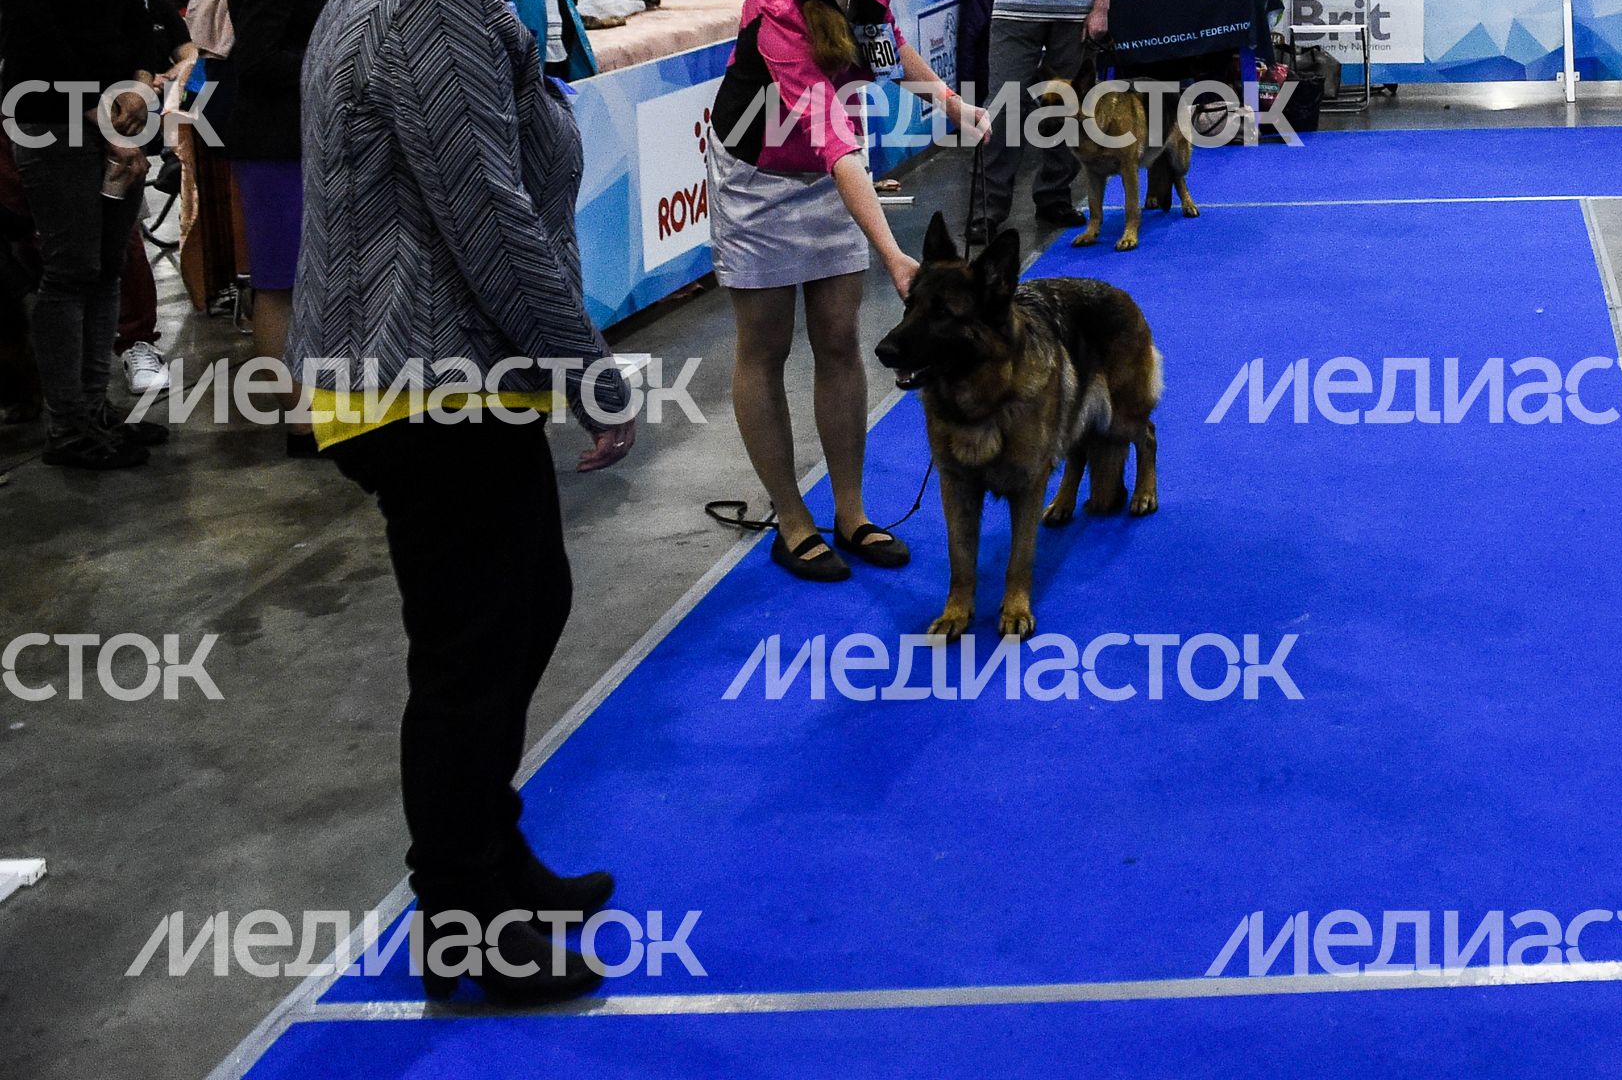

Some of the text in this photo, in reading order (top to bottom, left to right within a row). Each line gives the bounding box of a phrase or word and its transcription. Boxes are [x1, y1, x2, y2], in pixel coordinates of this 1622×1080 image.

[1132, 31, 1198, 48] KYNOLOGICAL
[1200, 22, 1250, 38] FEDERATIO
[658, 179, 708, 241] ROYA
